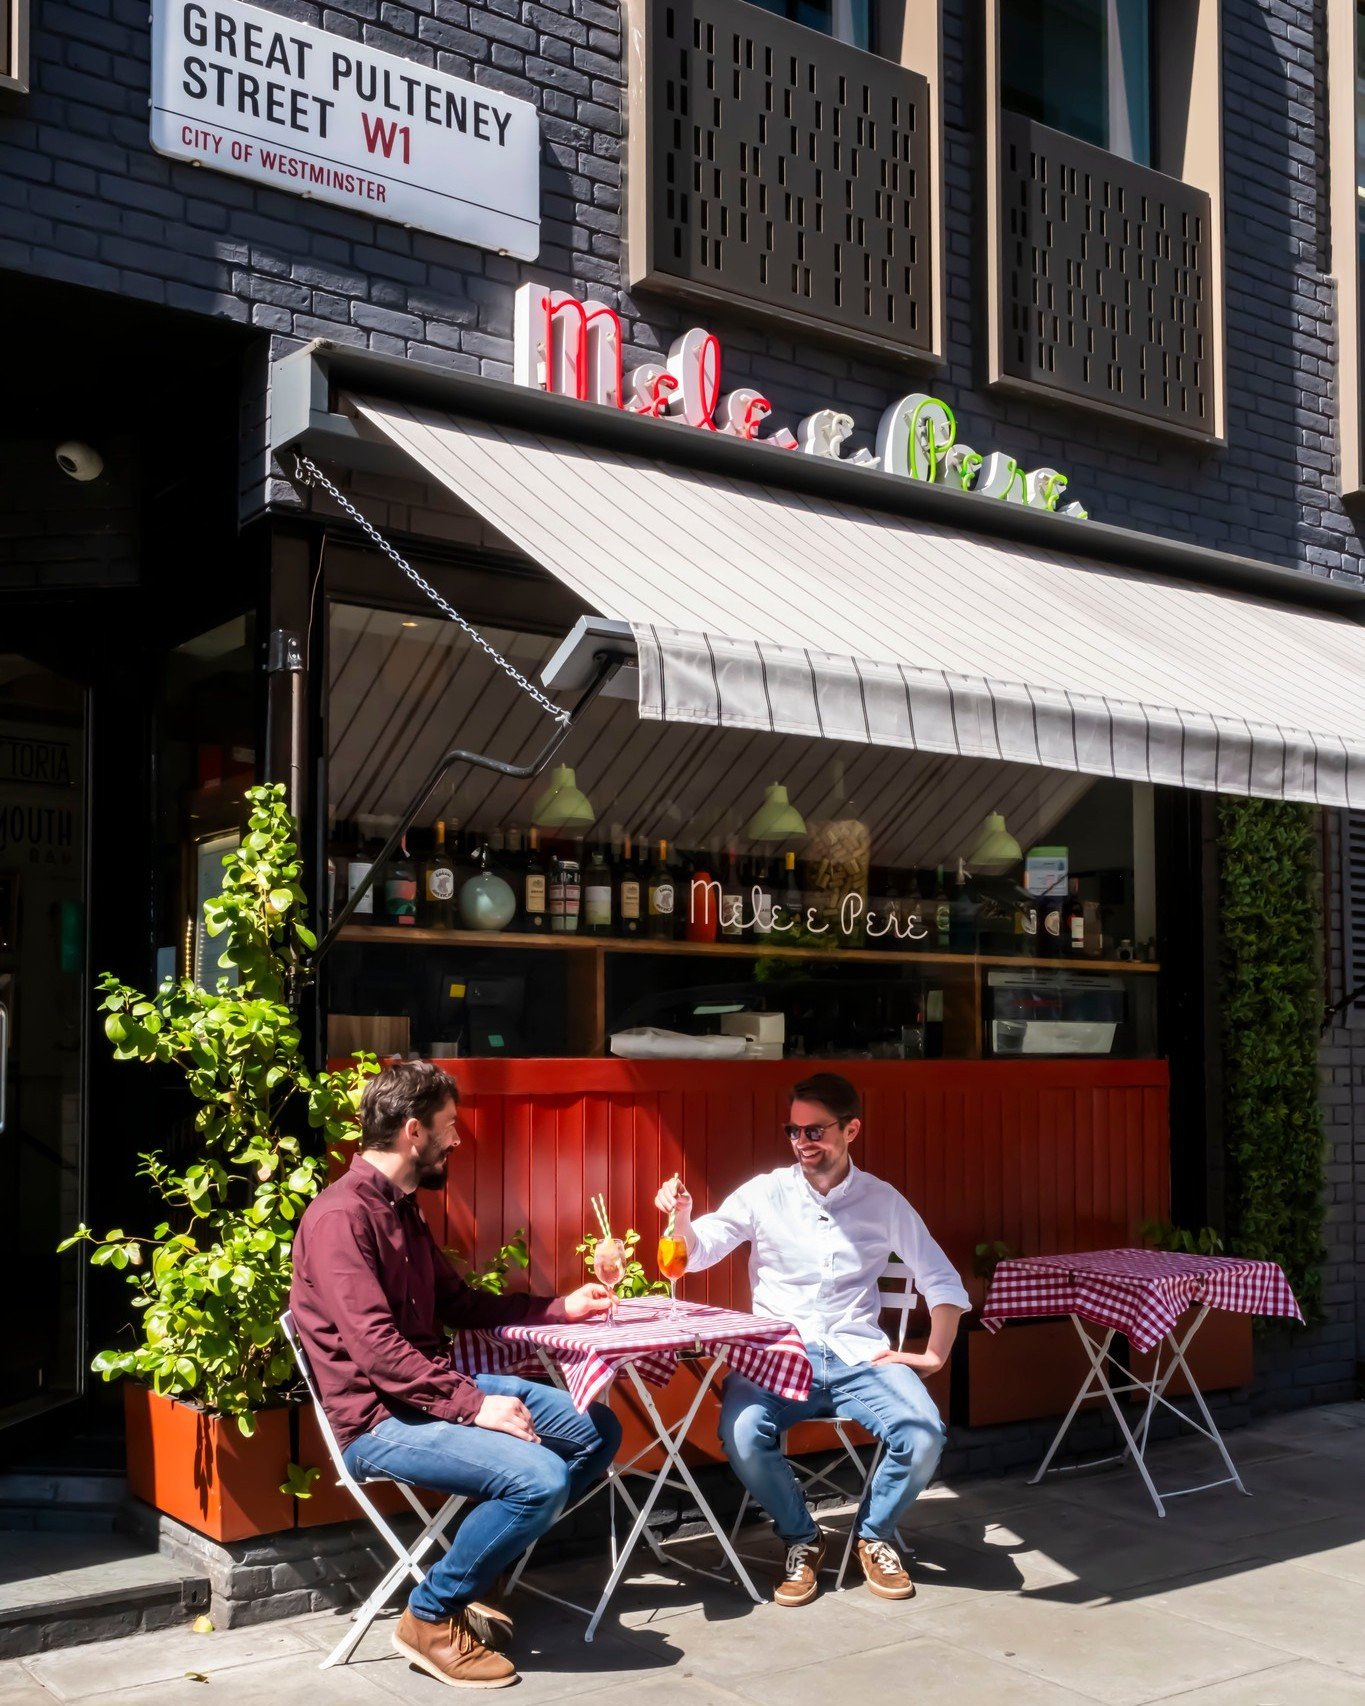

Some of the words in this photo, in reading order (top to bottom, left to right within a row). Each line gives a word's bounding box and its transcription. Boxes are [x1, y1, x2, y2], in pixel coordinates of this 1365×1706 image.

[182, 56, 335, 138] STREET
[361, 112, 411, 165] W1
[183, 3, 313, 80] GREAT
[332, 52, 513, 147] PULTENEY
[181, 126, 223, 155] CITY
[231, 141, 254, 163] OF
[260, 148, 387, 203] WESTMINSTER
[690, 879, 793, 930] Mele
[841, 892, 928, 939] Pere
